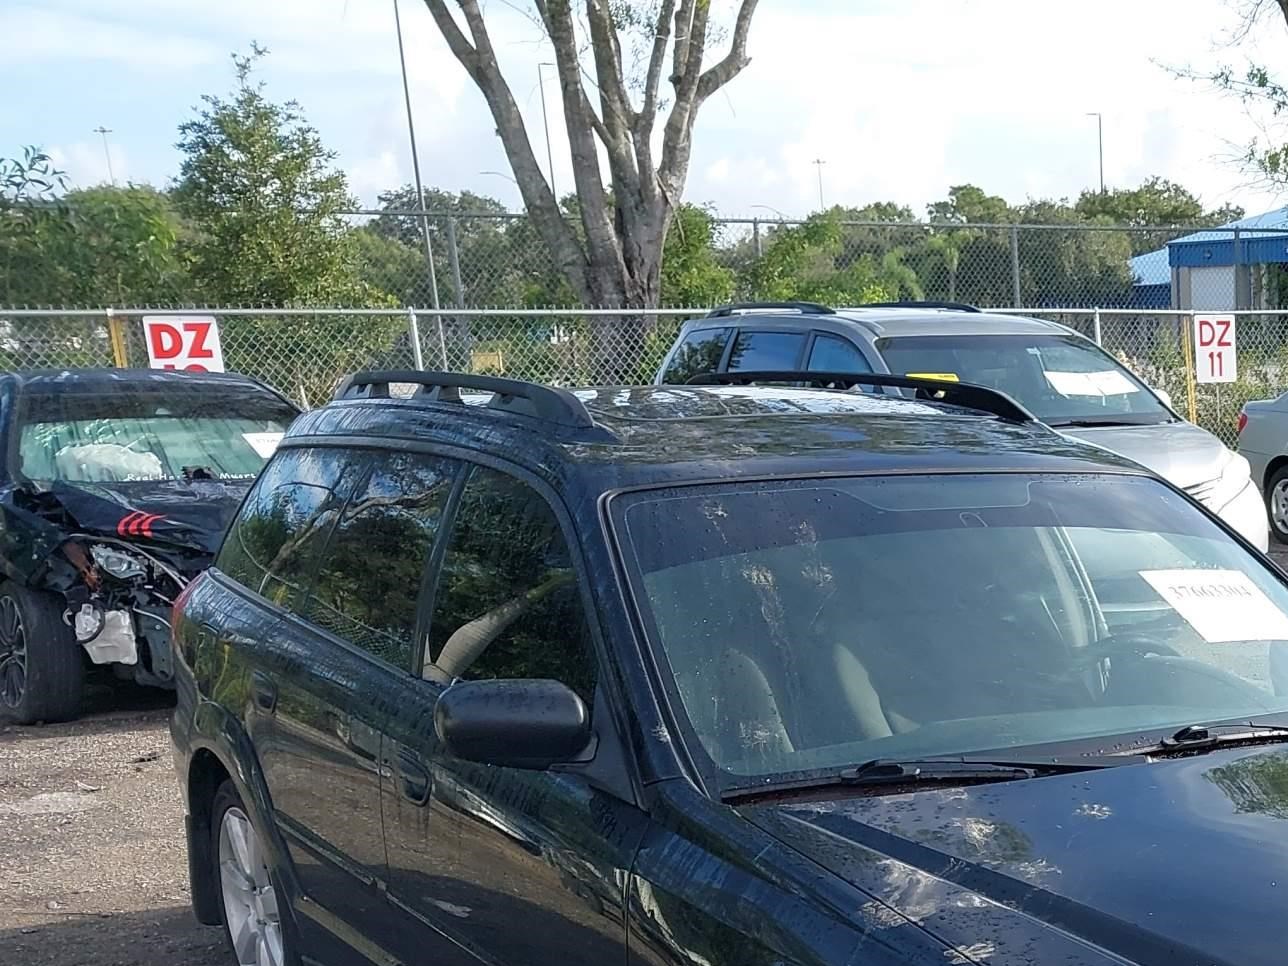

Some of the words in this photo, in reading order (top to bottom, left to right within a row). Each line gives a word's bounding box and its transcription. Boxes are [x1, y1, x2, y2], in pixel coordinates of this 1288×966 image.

[148, 322, 214, 359] DZ
[1199, 320, 1232, 347] DZ
[1208, 351, 1223, 377] 11
